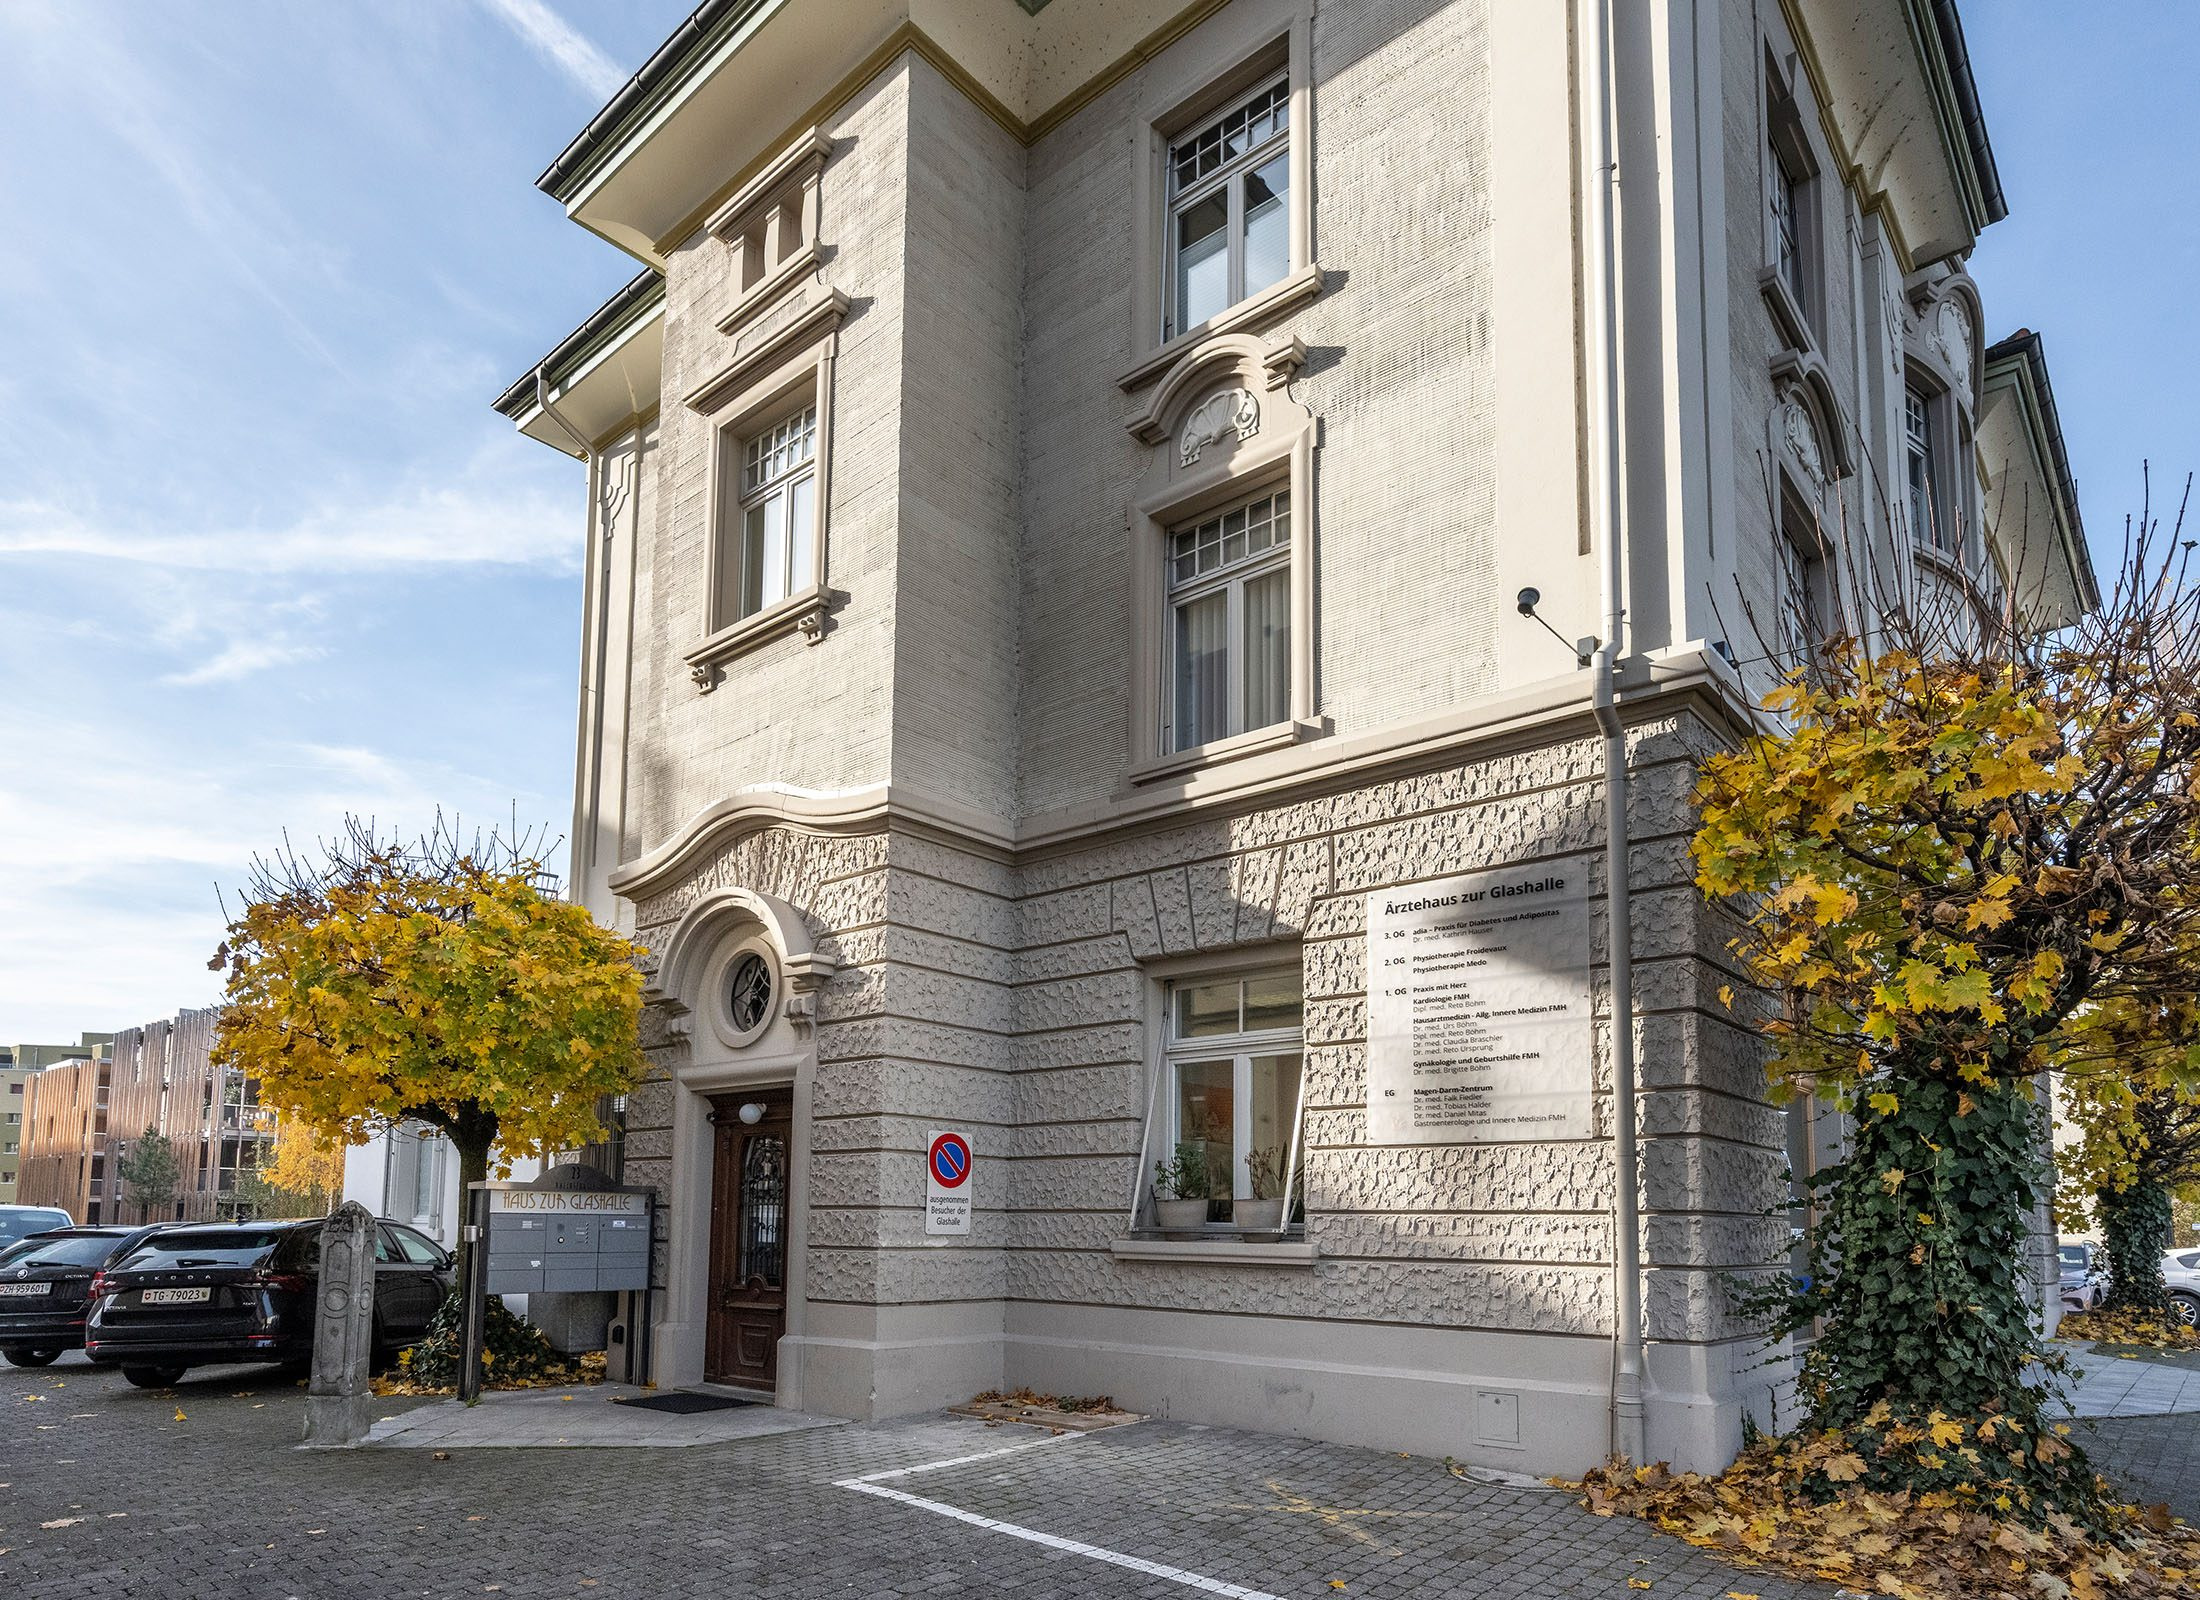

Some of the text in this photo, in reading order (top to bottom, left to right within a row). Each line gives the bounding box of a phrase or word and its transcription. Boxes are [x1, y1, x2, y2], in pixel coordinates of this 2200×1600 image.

[1384, 877, 1565, 915] Ärztehaus zur Glashalle
[1393, 930, 1405, 938] OG
[1413, 927, 1428, 935] adia
[1434, 923, 1456, 932] Praxis
[1456, 921, 1468, 929] für
[1469, 917, 1501, 928] Diabetes
[1503, 914, 1518, 922] und
[1519, 909, 1560, 920] Adipositas
[1442, 930, 1467, 939] Kathrin
[1469, 926, 1494, 935] Hauser
[1393, 957, 1405, 965] OG
[1413, 950, 1465, 963] Physiotherapie
[1466, 944, 1507, 955] Froidevaux
[1413, 959, 1487, 974] Physiotherapie Medo
[1394, 987, 1407, 996] OG
[1413, 994, 1452, 1005] Kardiologie
[1413, 1005, 1428, 1013] Dipl.
[1413, 1012, 1470, 1024] Hausarztmedizin
[1475, 1011, 1491, 1020] Allg.
[1492, 1009, 1516, 1017] Innere
[1518, 1005, 1547, 1015] Medizin
[1548, 1004, 1567, 1012] FMH
[1413, 1025, 1423, 1033] Dr.
[1424, 1023, 1441, 1031] med.
[1443, 1022, 1455, 1030] Urs
[1413, 1033, 1428, 1041] Dipl.
[1429, 1031, 1446, 1039] med.
[1424, 1039, 1441, 1047] med.
[1443, 1037, 1469, 1046] Claudia
[1424, 1047, 1441, 1055] med.
[1443, 1046, 1459, 1054] Reto
[1460, 1043, 1494, 1053] Ursprung
[1413, 1052, 1540, 1068] Gynäkologie und Geburtshilfe FMH
[1413, 1068, 1423, 1076] Dr.
[1424, 1067, 1442, 1075] med.
[1443, 1065, 1469, 1075] Brigitte
[1384, 1084, 1493, 1097] EG Magen-Darm-Zentrum
[1413, 1096, 1424, 1104] Dr.
[1425, 1095, 1442, 1103] med.
[1459, 1093, 1483, 1101] Fiedler
[1413, 1104, 1424, 1112] Dr.
[1444, 1102, 1467, 1110] Tobias
[1413, 1112, 1424, 1120] Dr.
[1425, 1111, 1442, 1119] med.
[1444, 1110, 1466, 1118] Daniel
[1414, 1113, 1566, 1127] Gastroenterologie und Innere Medizin FMH
[503, 1192, 631, 1210] HAUS ZUR GLASHALLE
[930, 1196, 969, 1205] ausgenommen
[931, 1206, 967, 1214] Besucher der
[936, 1217, 961, 1225] Glashalle
